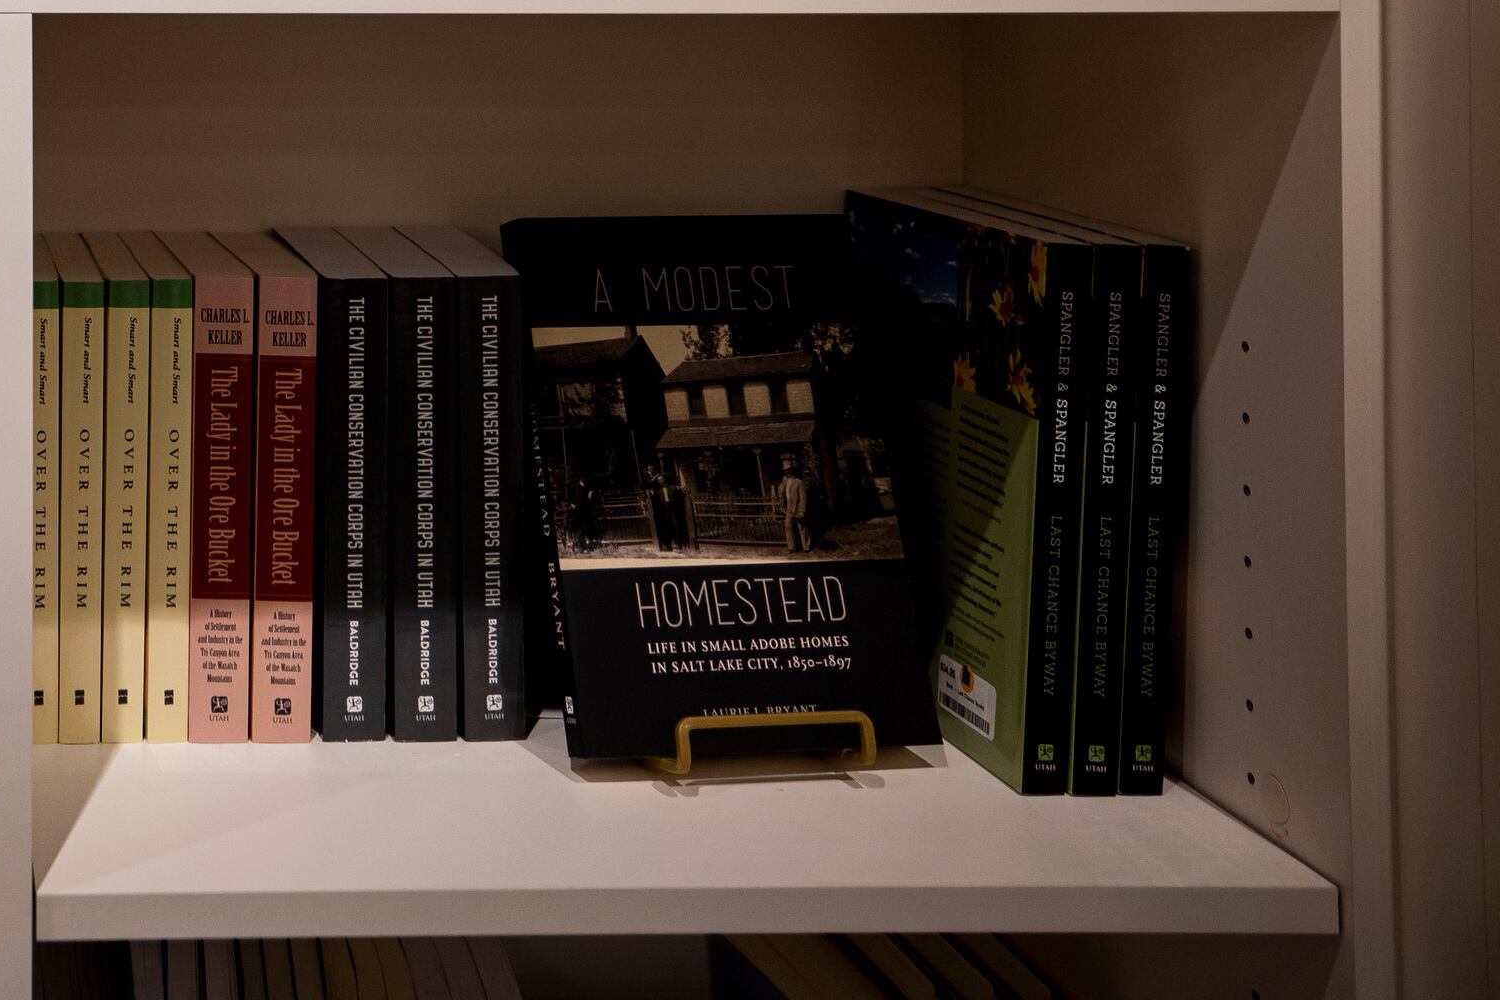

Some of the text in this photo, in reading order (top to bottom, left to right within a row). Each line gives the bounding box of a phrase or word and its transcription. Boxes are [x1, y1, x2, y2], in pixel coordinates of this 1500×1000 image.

[265, 310, 314, 326] CHARLES L.
[594, 265, 793, 313] A MODEST
[172, 317, 182, 404] Smart and Smart
[272, 332, 307, 348] KELLER
[1053, 291, 1074, 483] SPANGLER & SPANGLER
[270, 368, 302, 585] The Lady in the Ore Bucket
[482, 295, 501, 607] THE CIVILIAN CONSERVATION CORPS IN UTAH
[166, 429, 180, 608] OVER THE RIM
[547, 562, 566, 650] BRYANT
[635, 576, 846, 628] HOMESTEAD
[1043, 515, 1063, 696] LAST CHANCE BYWAY
[488, 619, 498, 684] BALDRIDGE
[647, 636, 849, 654] LIFE IN SMALL ADOBE HOMES
[652, 654, 851, 674] IN SALT LAKE CITY, 1850–1897
[272, 714, 293, 724] UTAH
[1035, 763, 1056, 771] UTAH
